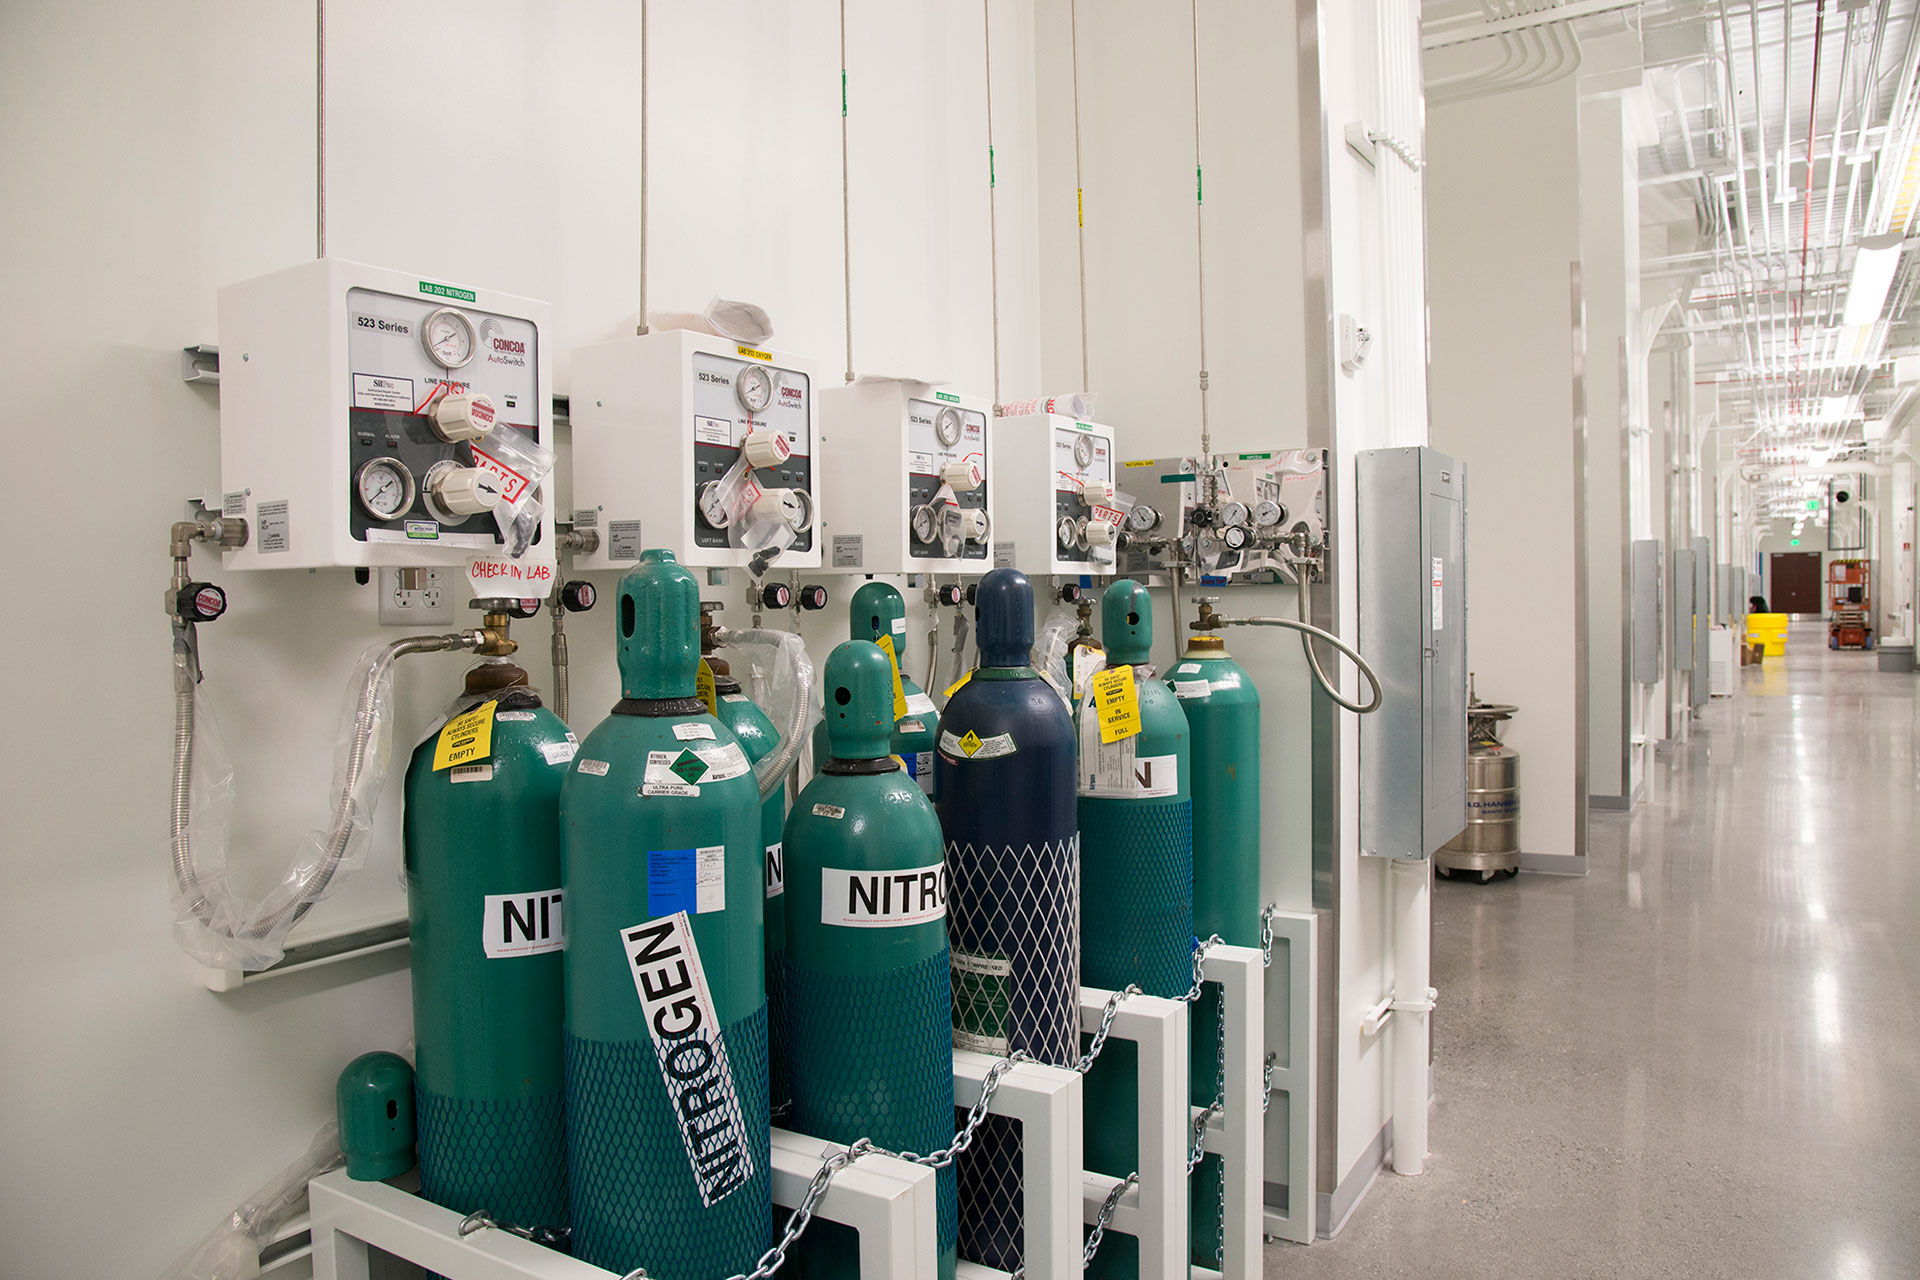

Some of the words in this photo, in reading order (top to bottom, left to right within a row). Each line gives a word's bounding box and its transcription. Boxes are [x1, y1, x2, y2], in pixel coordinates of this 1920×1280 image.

[421, 284, 432, 293] LAB
[434, 286, 444, 296] 202
[446, 288, 474, 301] NITROGEN
[358, 317, 375, 328] 523
[378, 320, 408, 334] Series
[493, 338, 525, 354] CONCOA
[488, 354, 525, 367] AutoSwitch
[756, 350, 772, 360] OXYGEN
[699, 372, 710, 381] 523
[711, 374, 729, 385] Series
[782, 386, 802, 398] CONCOA
[1095, 508, 1119, 522] PARTS
[472, 561, 508, 578] CHECK
[511, 565, 521, 580] IN
[527, 565, 550, 580] LAB
[1107, 695, 1125, 705] EMPTY
[1108, 712, 1130, 723] SERVICE
[449, 747, 475, 761] EMPTY
[628, 921, 745, 1202] NITROGEN
